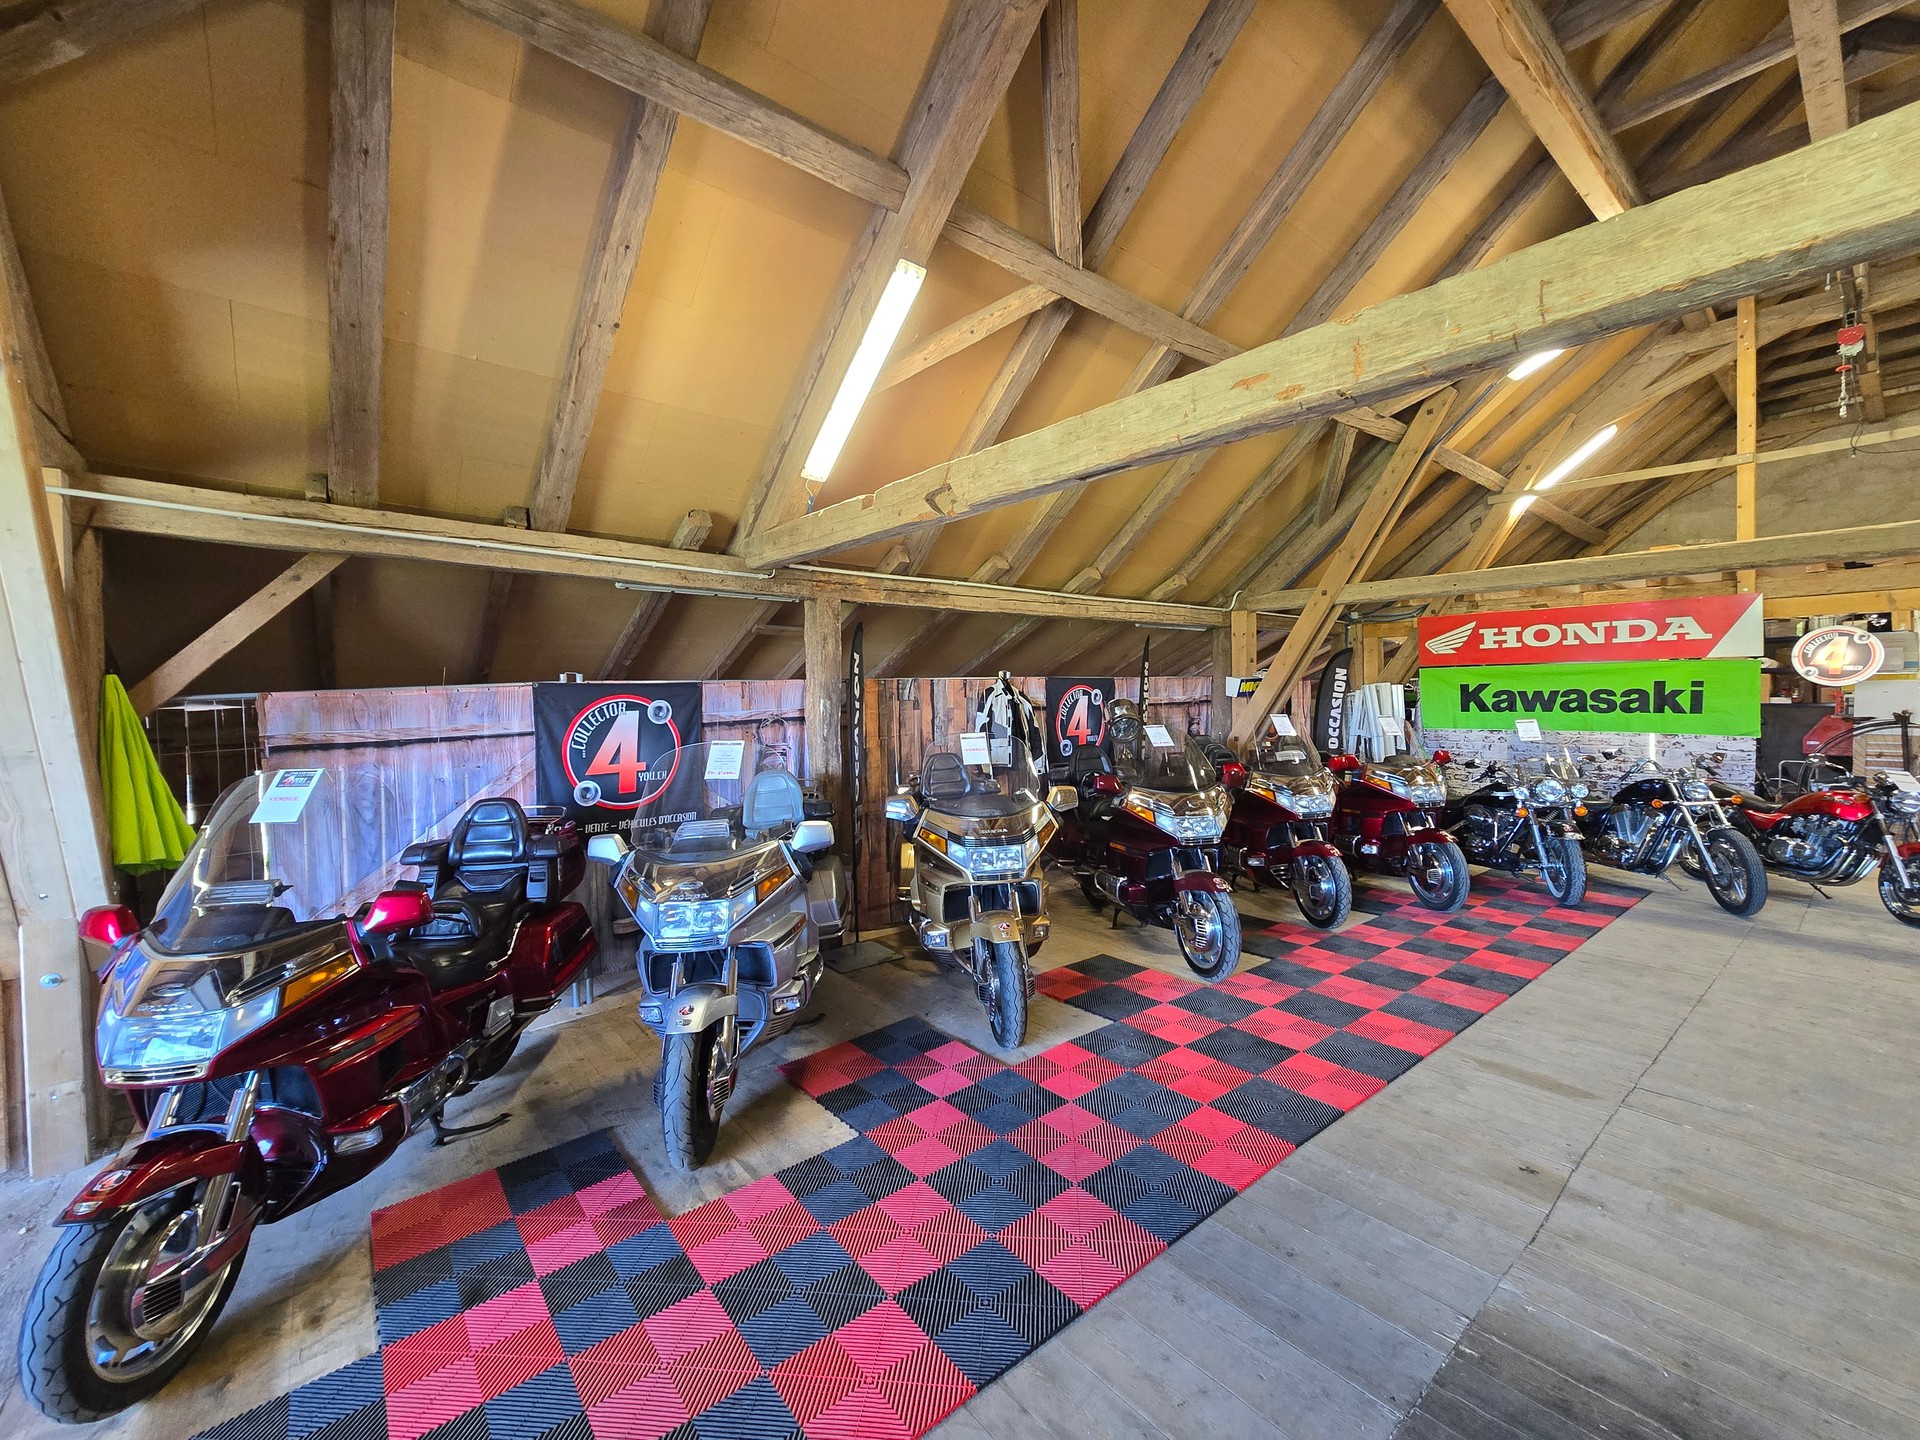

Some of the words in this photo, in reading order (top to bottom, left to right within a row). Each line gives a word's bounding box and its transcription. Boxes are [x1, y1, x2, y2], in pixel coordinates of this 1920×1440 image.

[1479, 616, 1712, 649] HONDA
[1809, 636, 1849, 675] 4
[1328, 667, 1348, 750] OCCASION
[1459, 680, 1705, 715] Kawasaki
[1066, 695, 1091, 746] 4
[585, 710, 646, 794] 4
[638, 770, 667, 782] YOU.CH
[585, 822, 610, 833] VENTE
